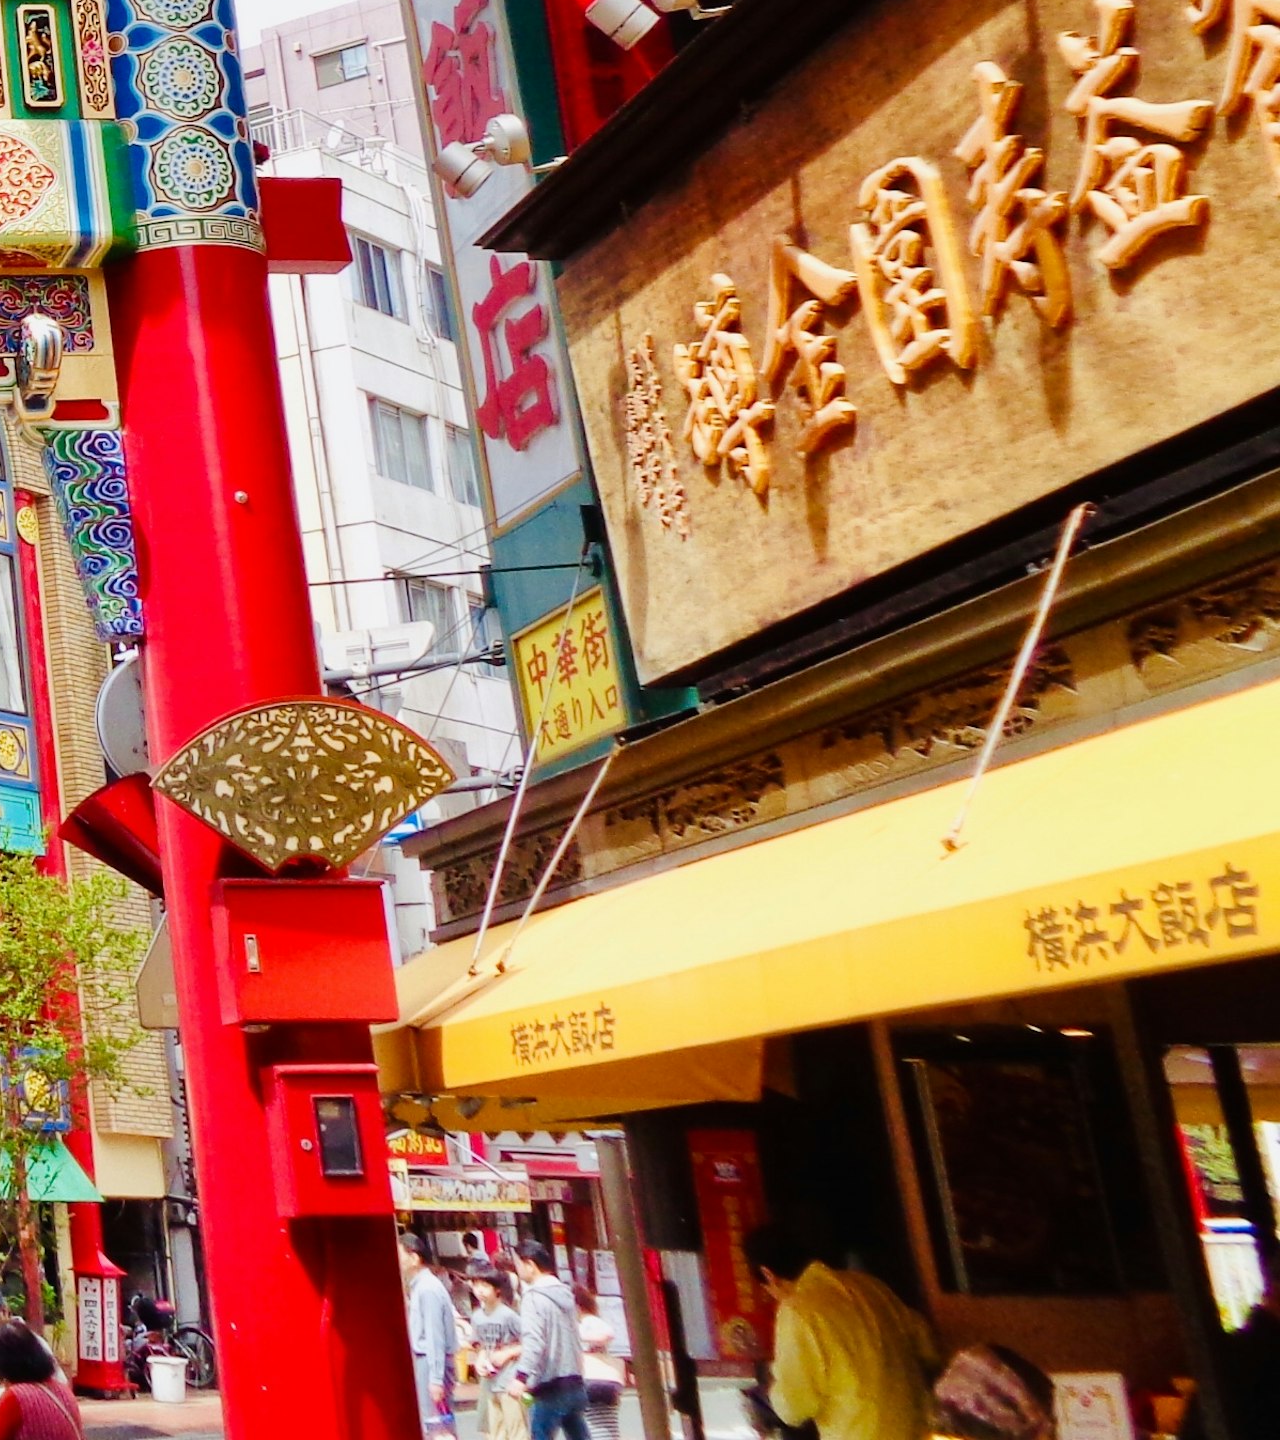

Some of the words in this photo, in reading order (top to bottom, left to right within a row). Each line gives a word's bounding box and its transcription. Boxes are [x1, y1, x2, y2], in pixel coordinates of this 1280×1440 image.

[527, 611, 608, 701] 中華街
[538, 684, 618, 750] 大通り入口
[1024, 862, 1259, 972] 横浜大飯店
[510, 1001, 615, 1066] 横浜大飯店
